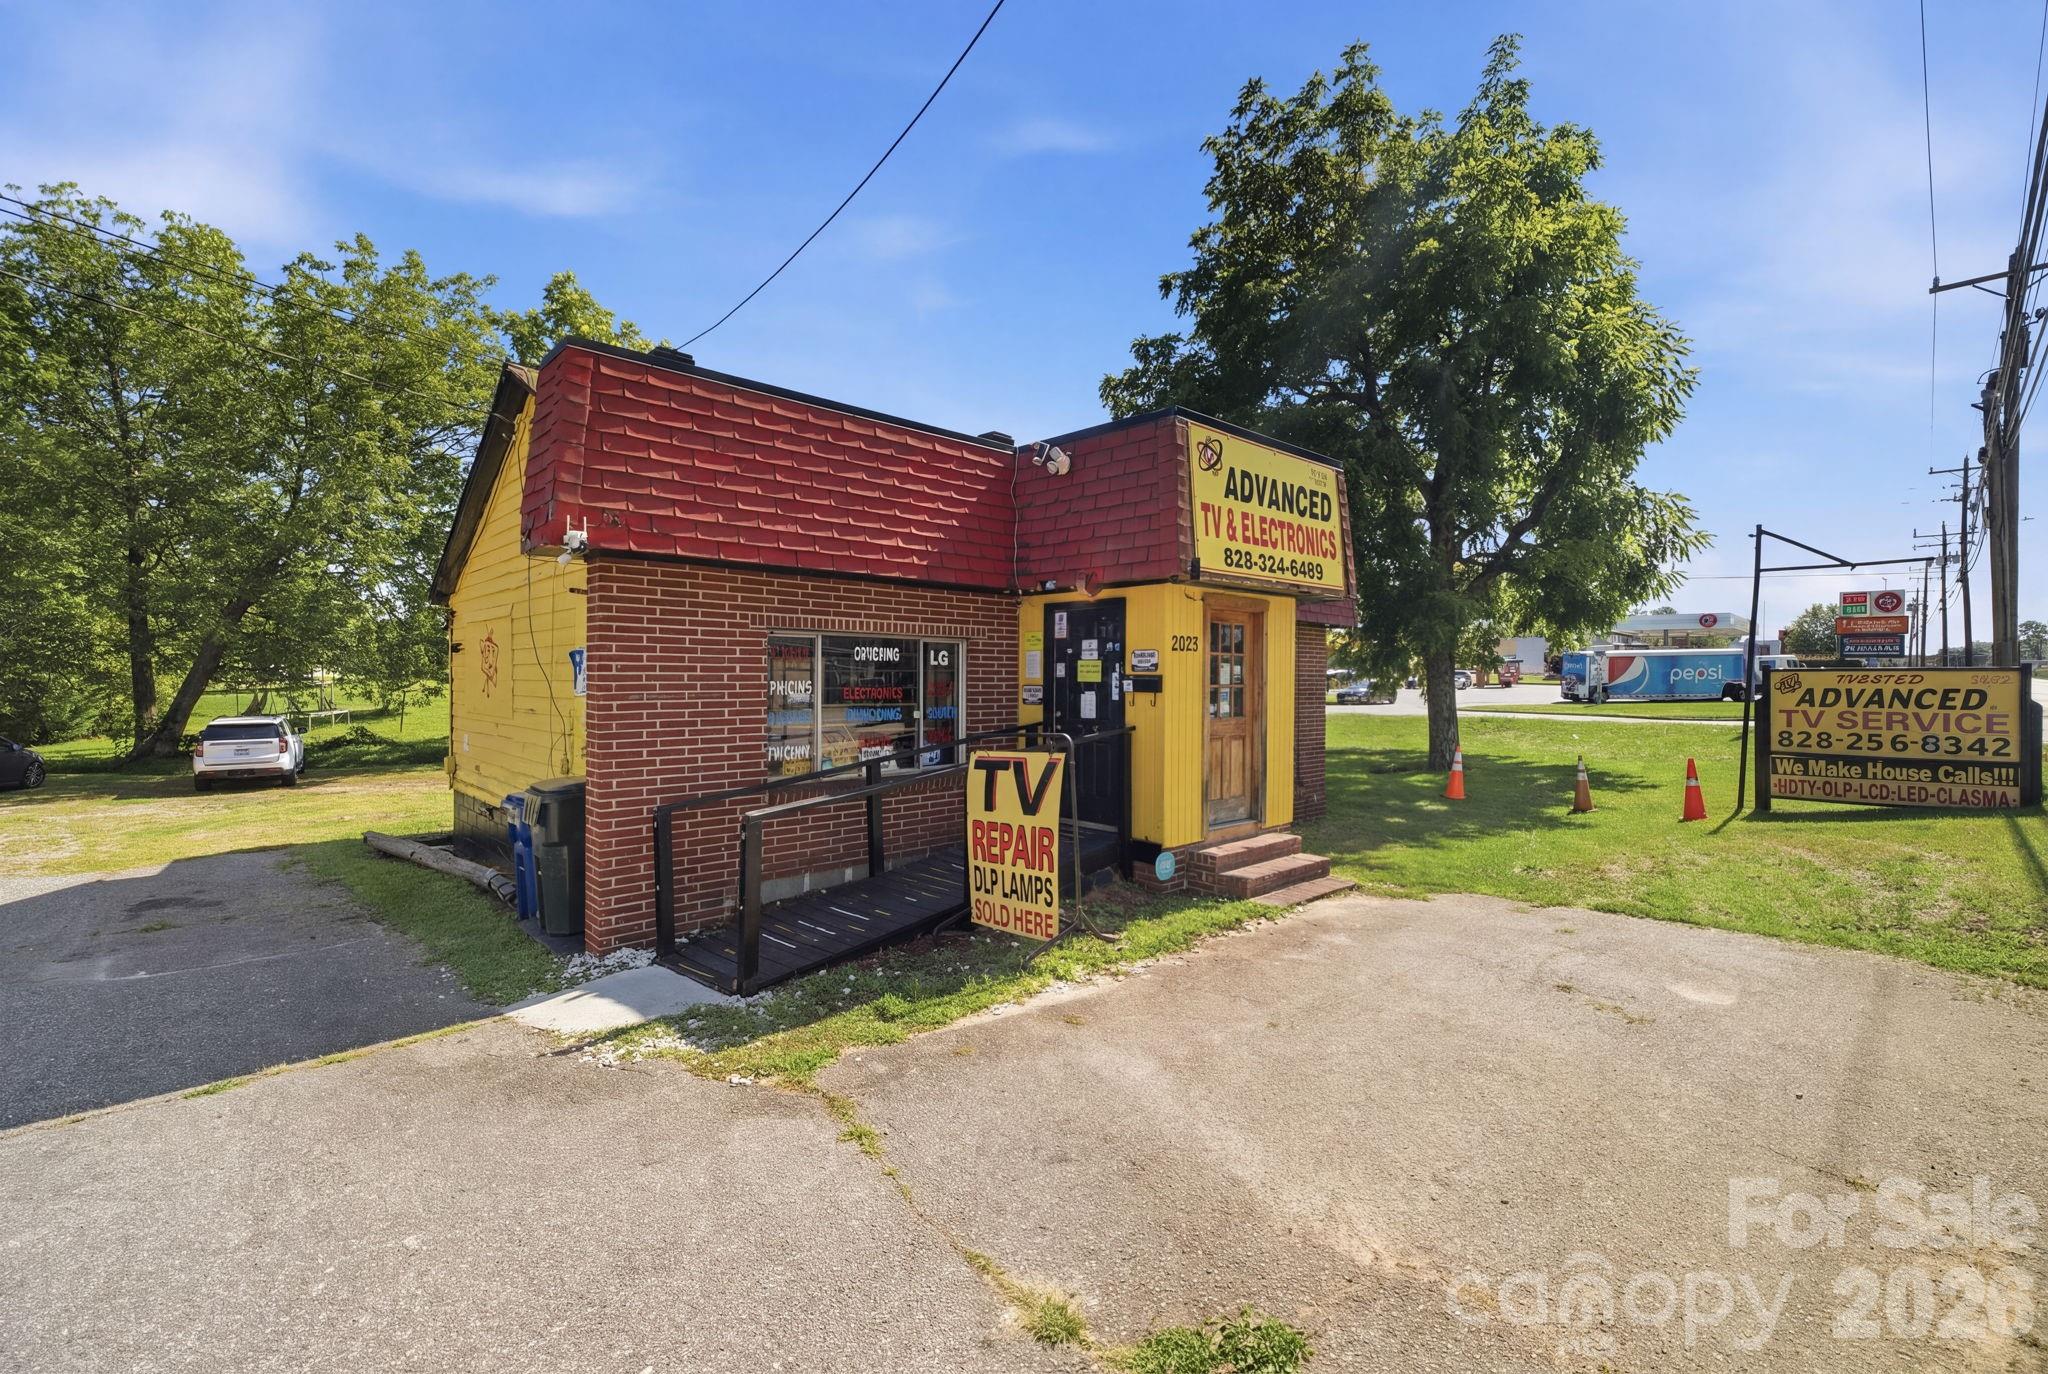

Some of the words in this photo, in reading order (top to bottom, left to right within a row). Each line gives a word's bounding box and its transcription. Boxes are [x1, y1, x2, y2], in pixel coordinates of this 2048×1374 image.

[1224, 466, 1332, 522] ADVANCED
[1200, 502, 1222, 539] TV
[1227, 508, 1238, 542] &
[1241, 511, 1337, 560] ELECTRONICS
[1224, 548, 1323, 580] 828-324-6489
[930, 650, 949, 666] LG
[1171, 635, 1199, 652] 2023
[1670, 664, 1722, 684] pepsi
[1795, 688, 1988, 711] ADVANCED
[1779, 709, 1826, 729] TV
[1836, 711, 2010, 735] SERVICE
[1778, 731, 2011, 757] 828-256-8342
[974, 756, 1061, 816] TV
[1775, 758, 1804, 776] We
[1808, 759, 1862, 779] Make
[1867, 760, 1932, 782] House
[1938, 765, 2015, 786] Calls!!!
[972, 819, 1054, 873] REPAIR
[974, 865, 998, 895] DLP
[1001, 870, 1053, 908] LAMPS
[974, 898, 1010, 927] SOLD
[1013, 907, 1054, 939] HERE
